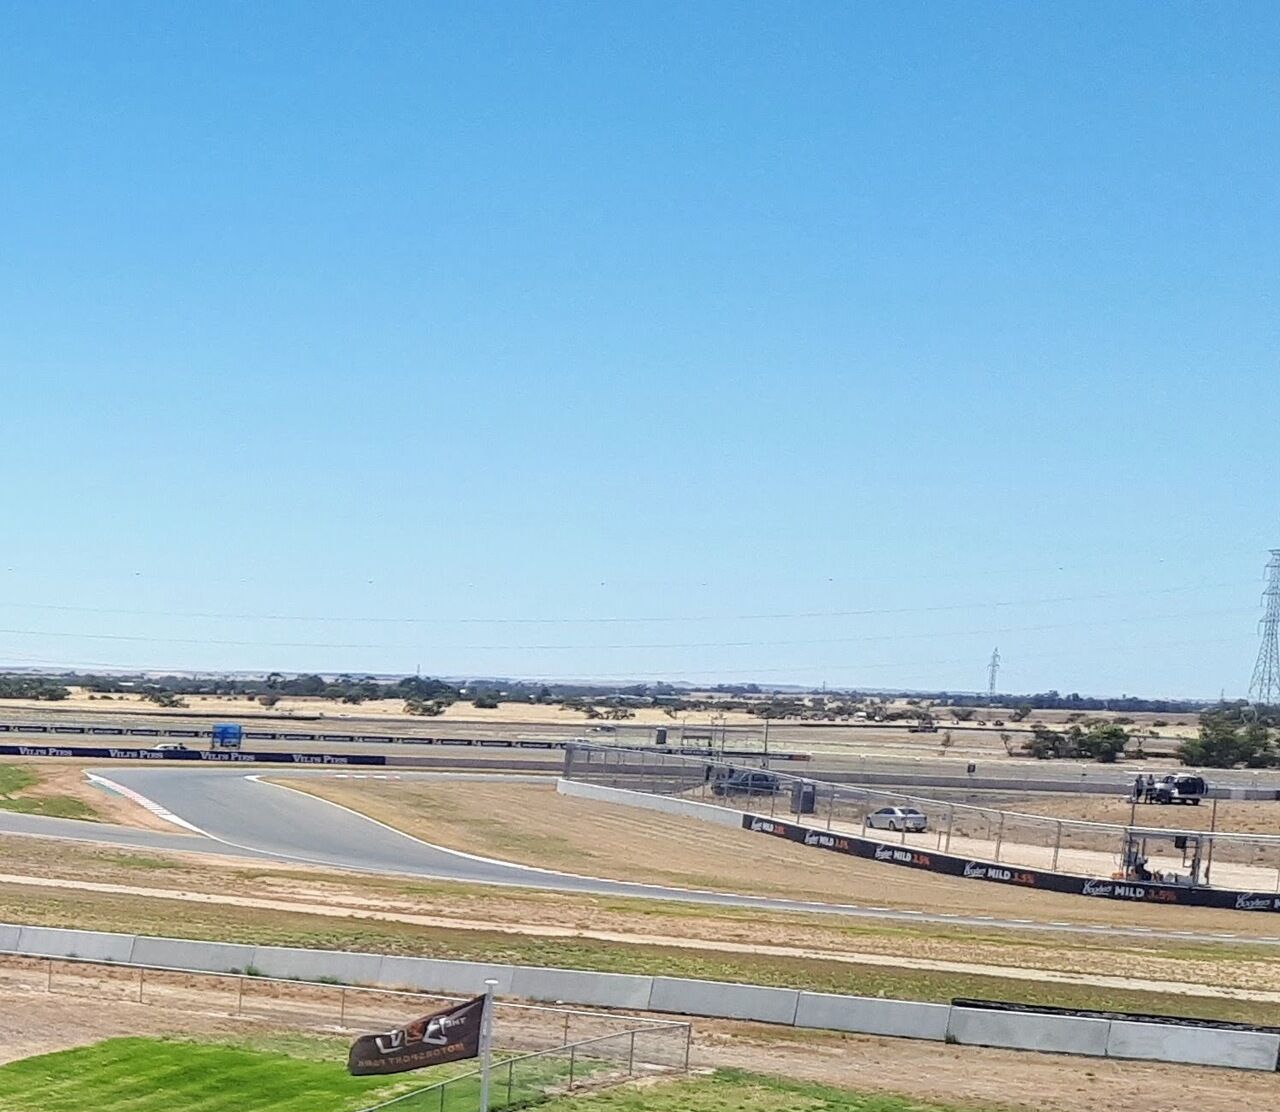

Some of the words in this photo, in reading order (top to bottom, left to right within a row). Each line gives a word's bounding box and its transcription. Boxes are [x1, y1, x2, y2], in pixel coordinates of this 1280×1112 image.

[893, 850, 912, 862] MILD
[987, 868, 1011, 881] MILD
[1114, 885, 1145, 898] MILD
